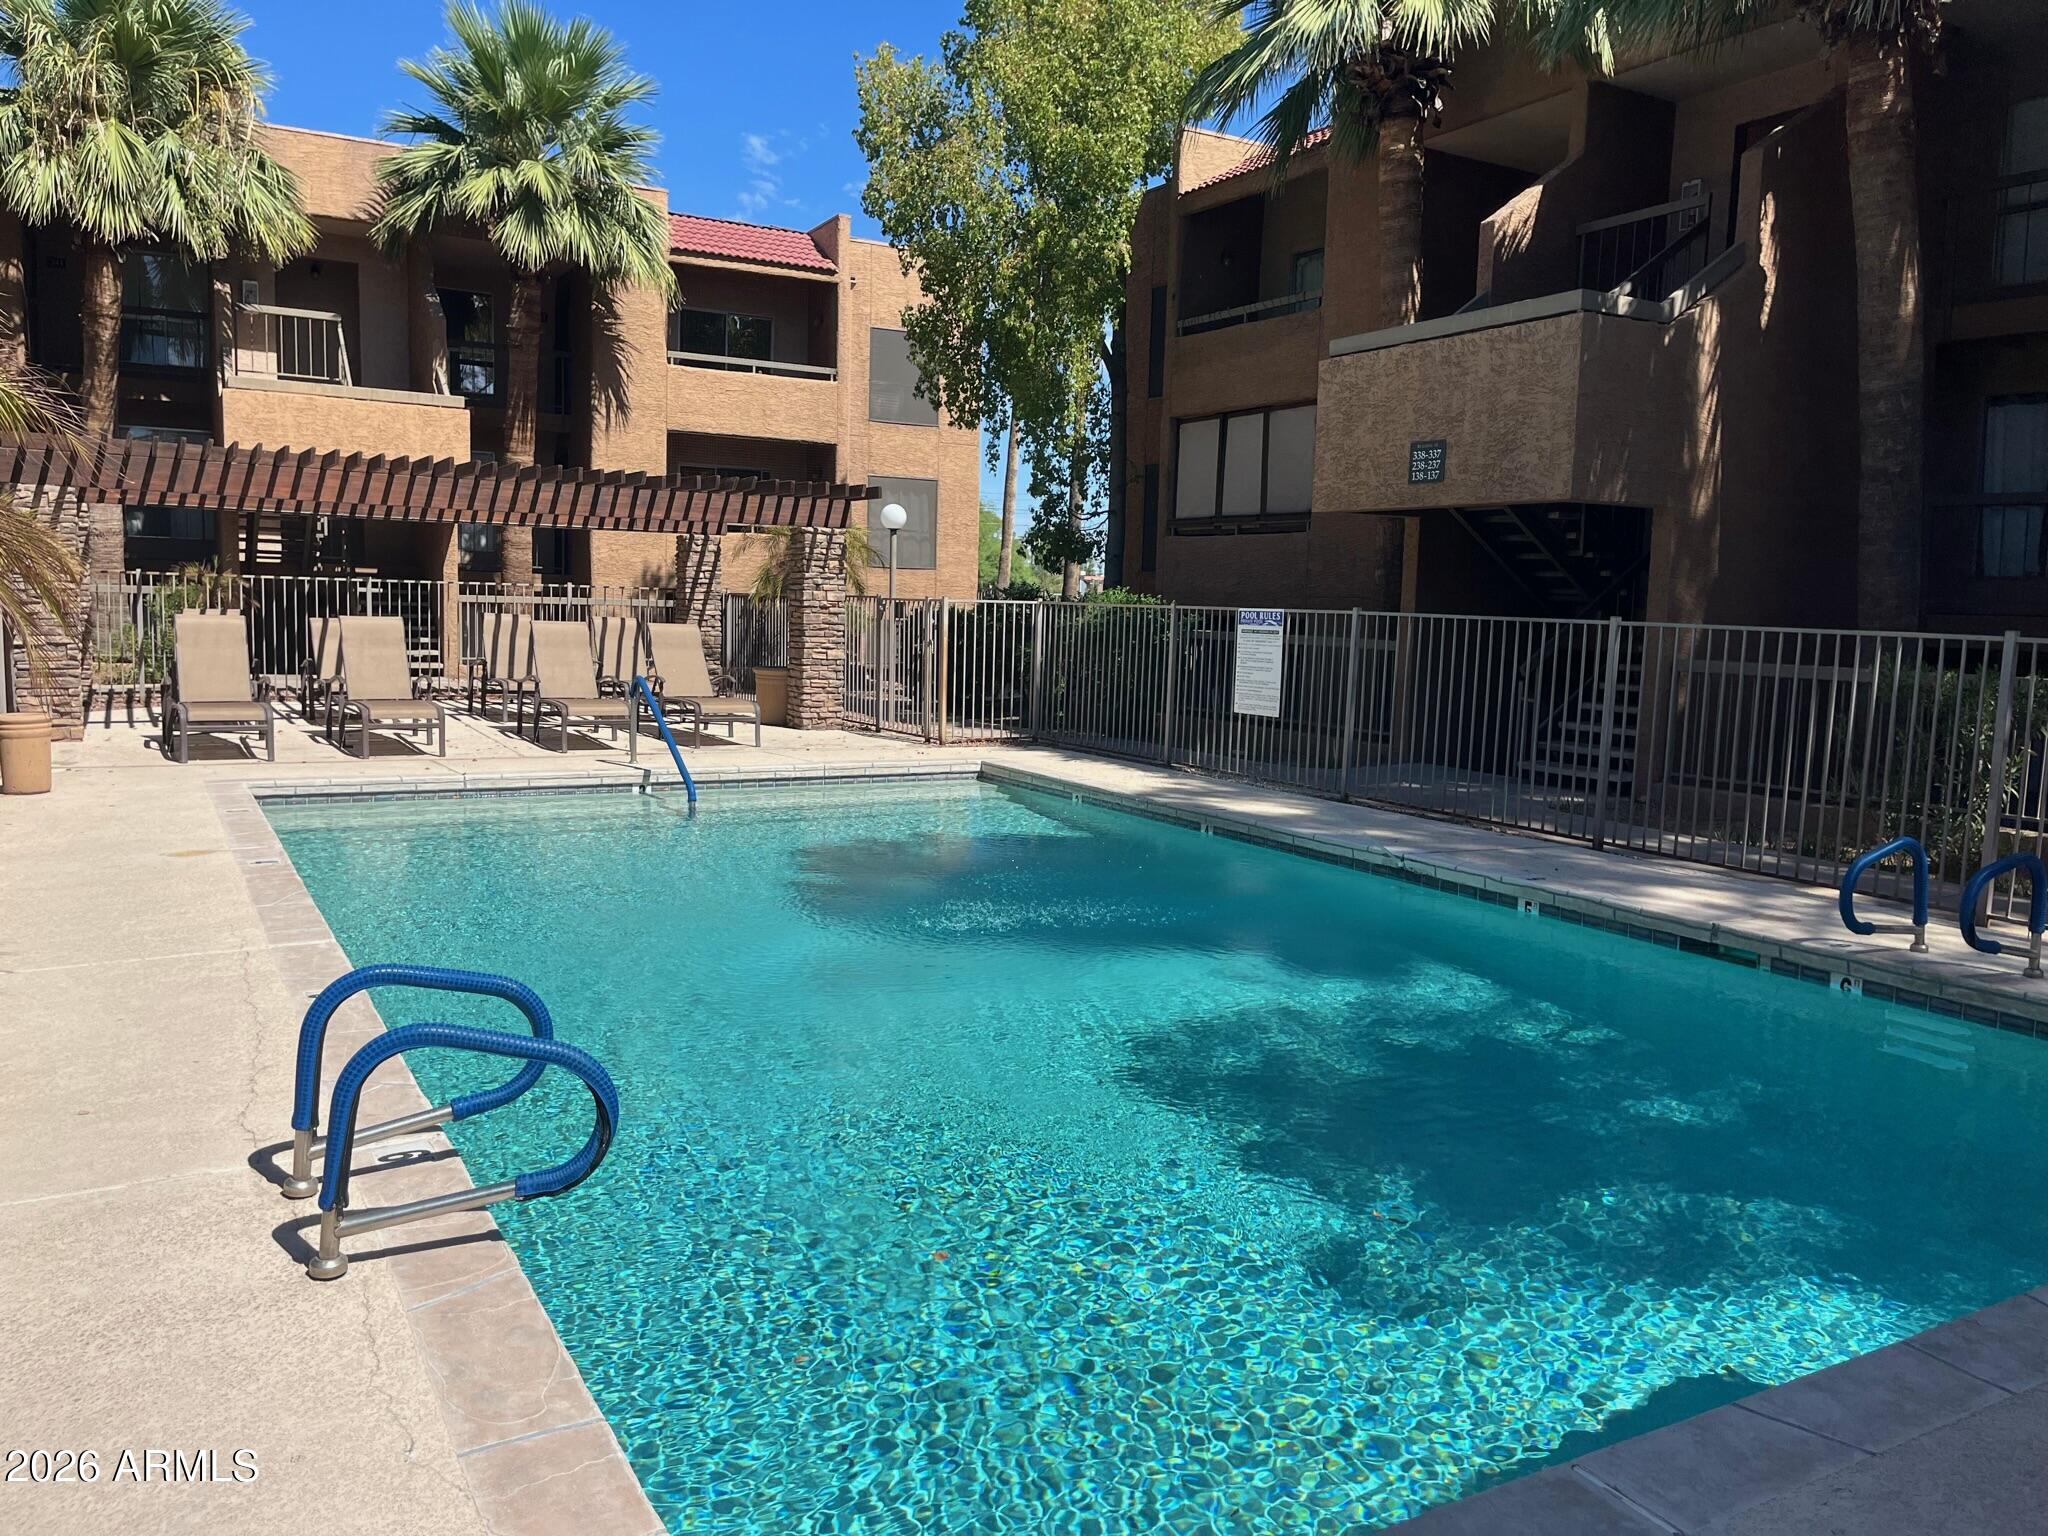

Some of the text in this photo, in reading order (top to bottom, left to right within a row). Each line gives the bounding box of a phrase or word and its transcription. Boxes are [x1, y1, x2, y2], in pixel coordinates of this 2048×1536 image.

[1412, 449, 1441, 460] 338-337
[1412, 460, 1441, 470] 238-237
[1412, 471, 1440, 481] 138-137
[1241, 611, 1281, 621] POOL RULES
